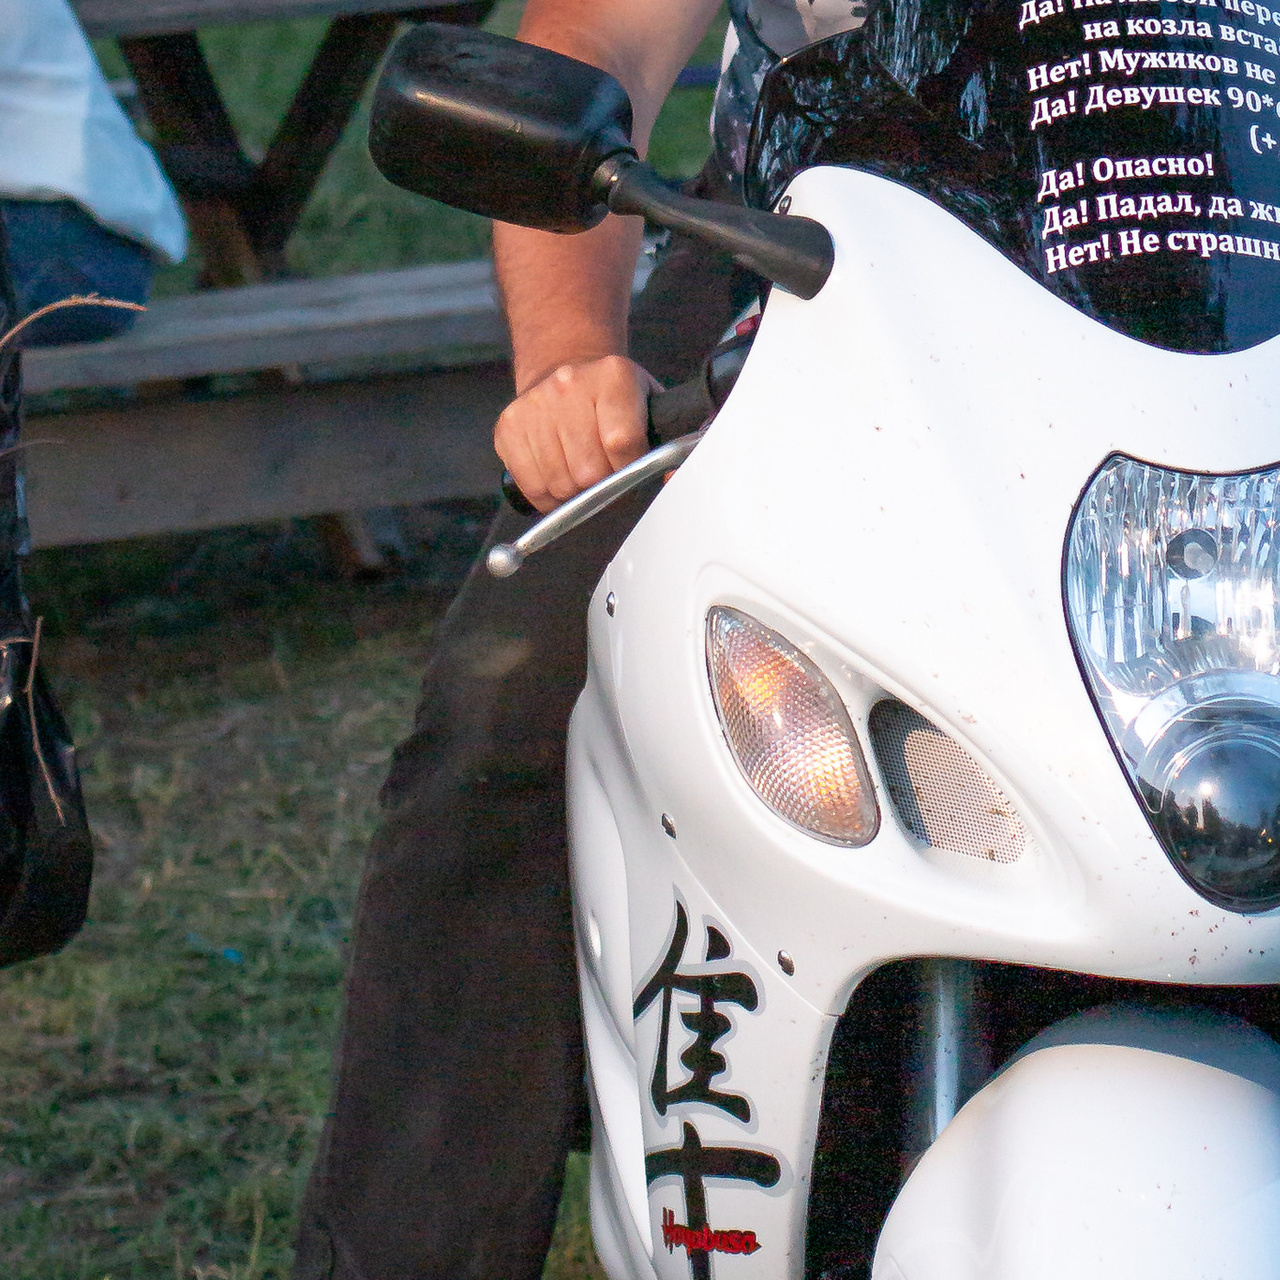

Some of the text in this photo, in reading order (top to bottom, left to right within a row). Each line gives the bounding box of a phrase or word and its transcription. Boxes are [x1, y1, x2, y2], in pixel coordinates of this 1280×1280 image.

[1083, 20, 1120, 40] на
[1126, 18, 1213, 38] козла
[1027, 53, 1092, 91] Нет!
[1098, 48, 1238, 76] Мужиков
[1244, 61, 1276, 84] не
[1031, 90, 1076, 130] Да!
[1084, 85, 1222, 115] Девушек
[1037, 153, 1214, 202] Да! Опасно!
[1041, 199, 1088, 240] Да!
[1097, 192, 1201, 220] Падал,
[1209, 196, 1243, 218] да
[1045, 234, 1111, 273] Нет!
[1118, 229, 1160, 256] Не
